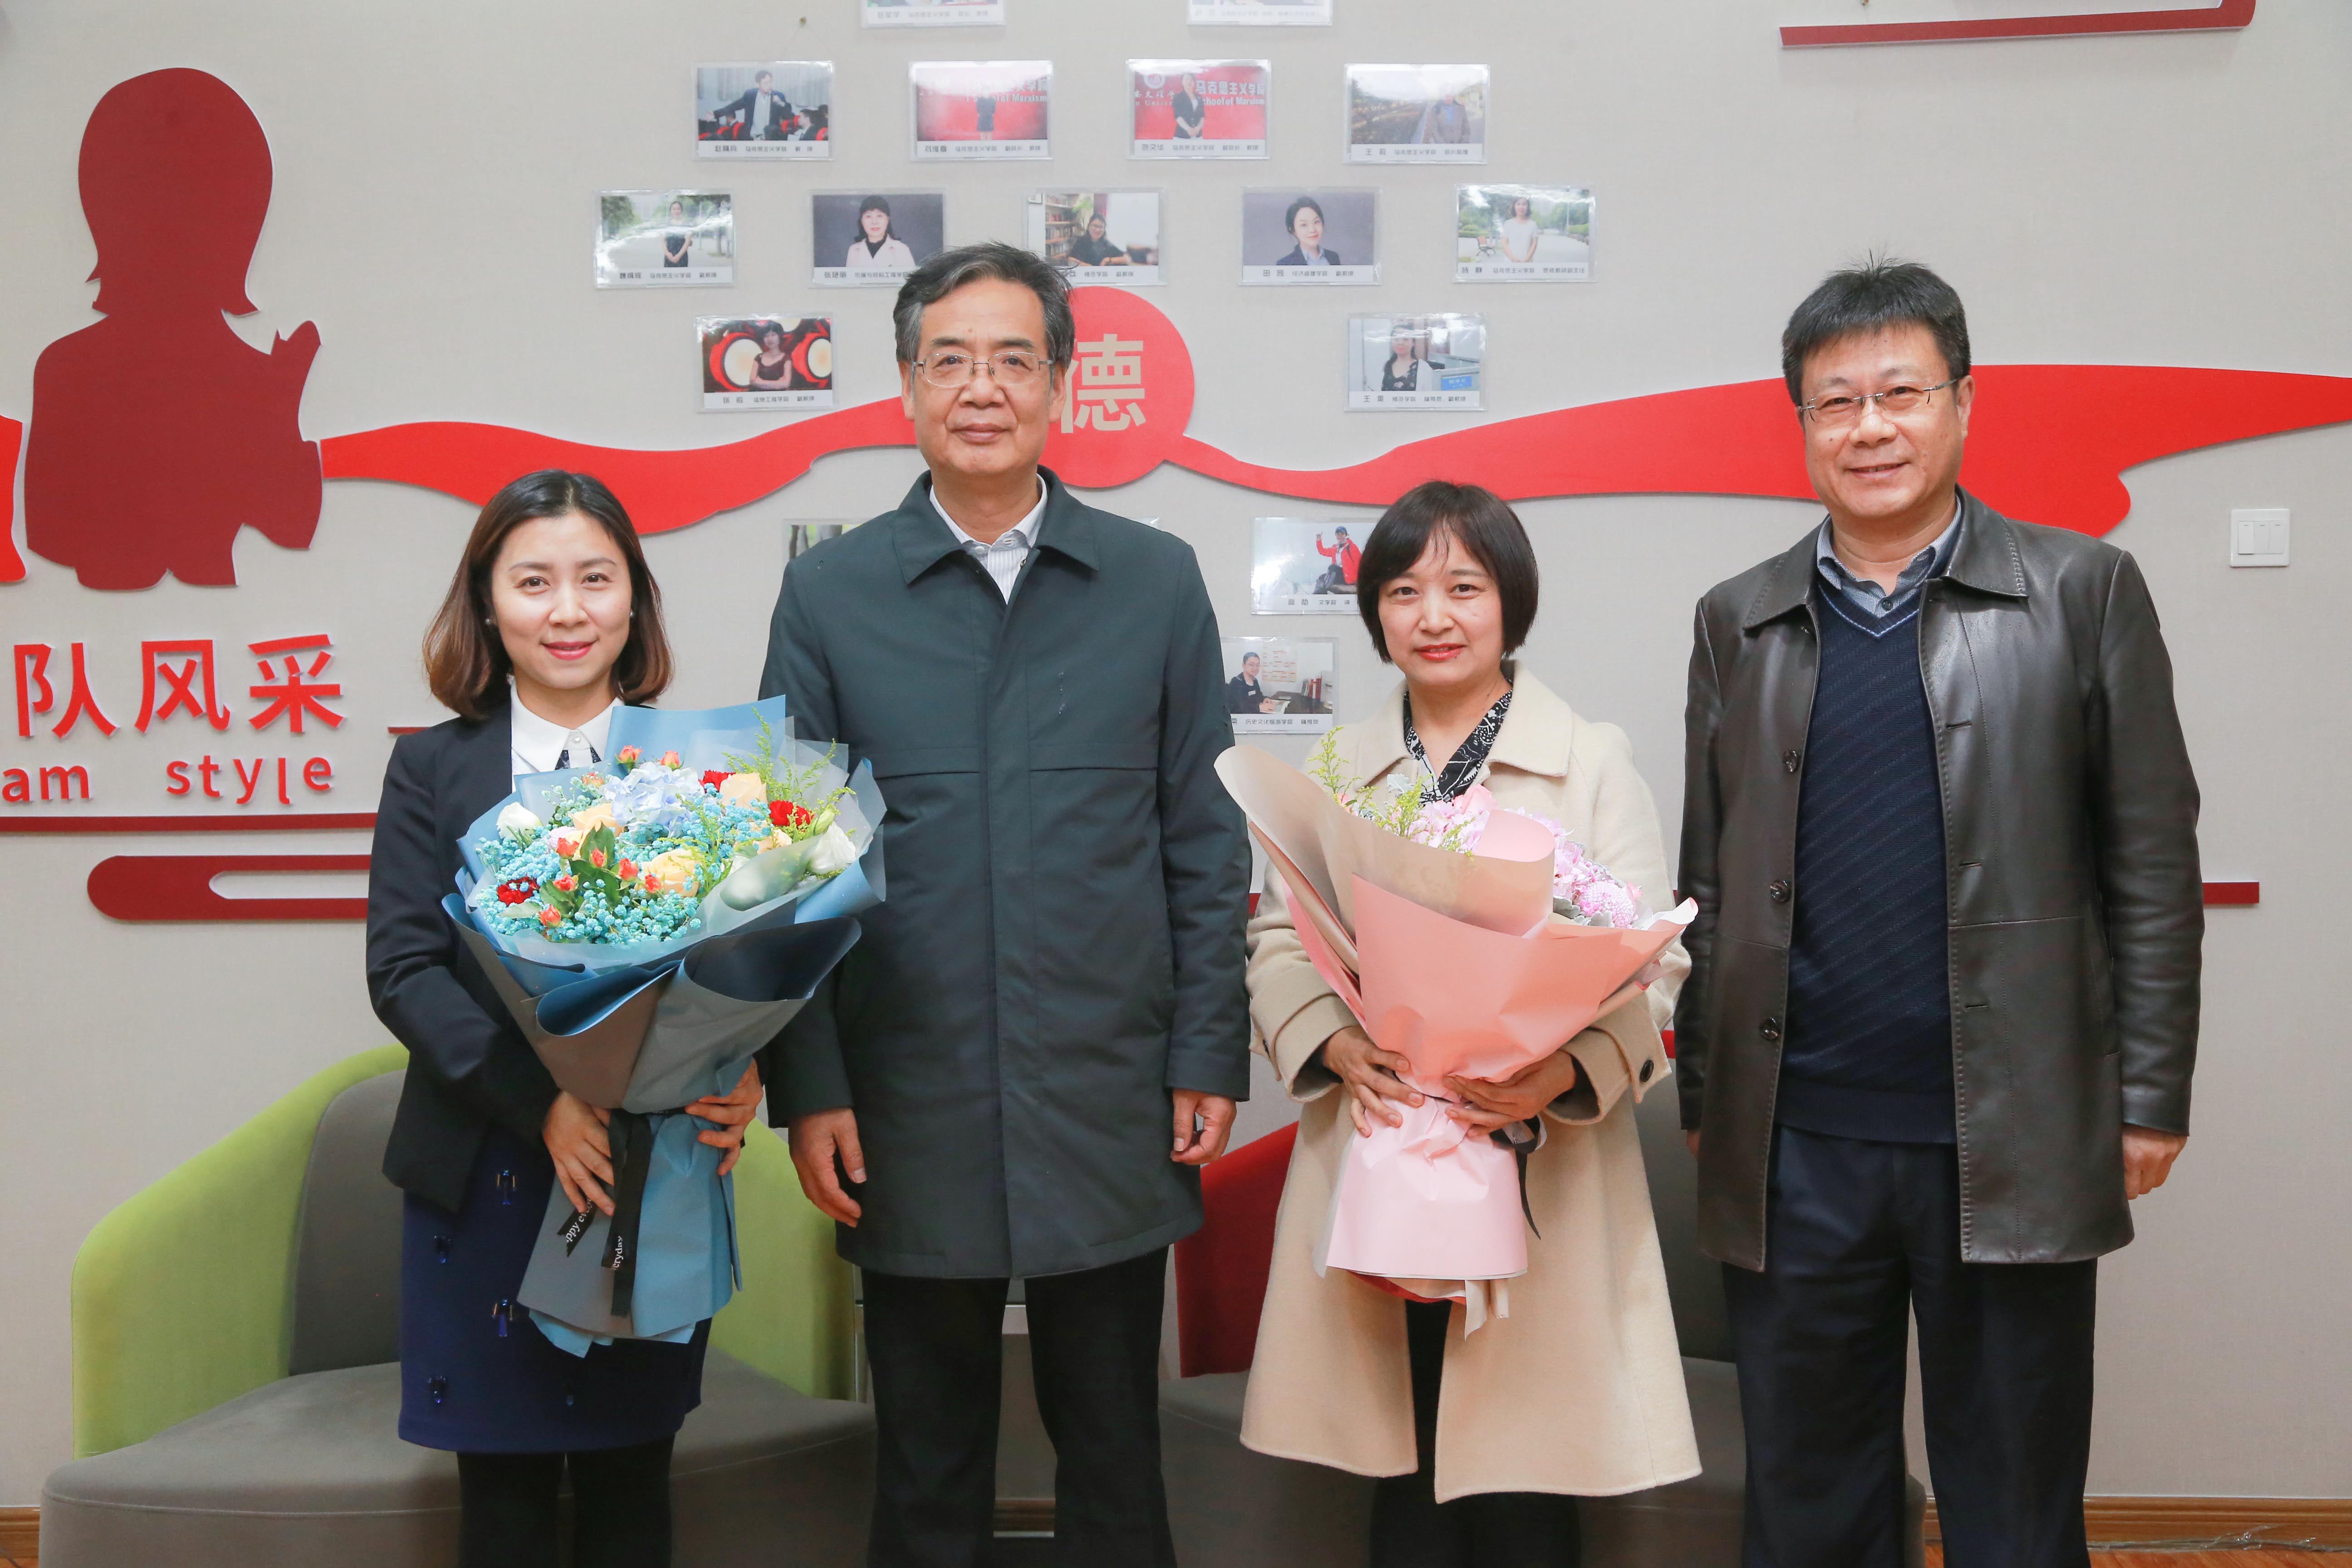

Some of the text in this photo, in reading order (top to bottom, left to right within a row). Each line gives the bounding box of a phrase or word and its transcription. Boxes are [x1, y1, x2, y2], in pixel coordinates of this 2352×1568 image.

[1061, 333, 1147, 434] 德
[14, 634, 348, 739] 队风采
[166, 755, 334, 805] style
[566, 1222, 580, 1242] ppy
